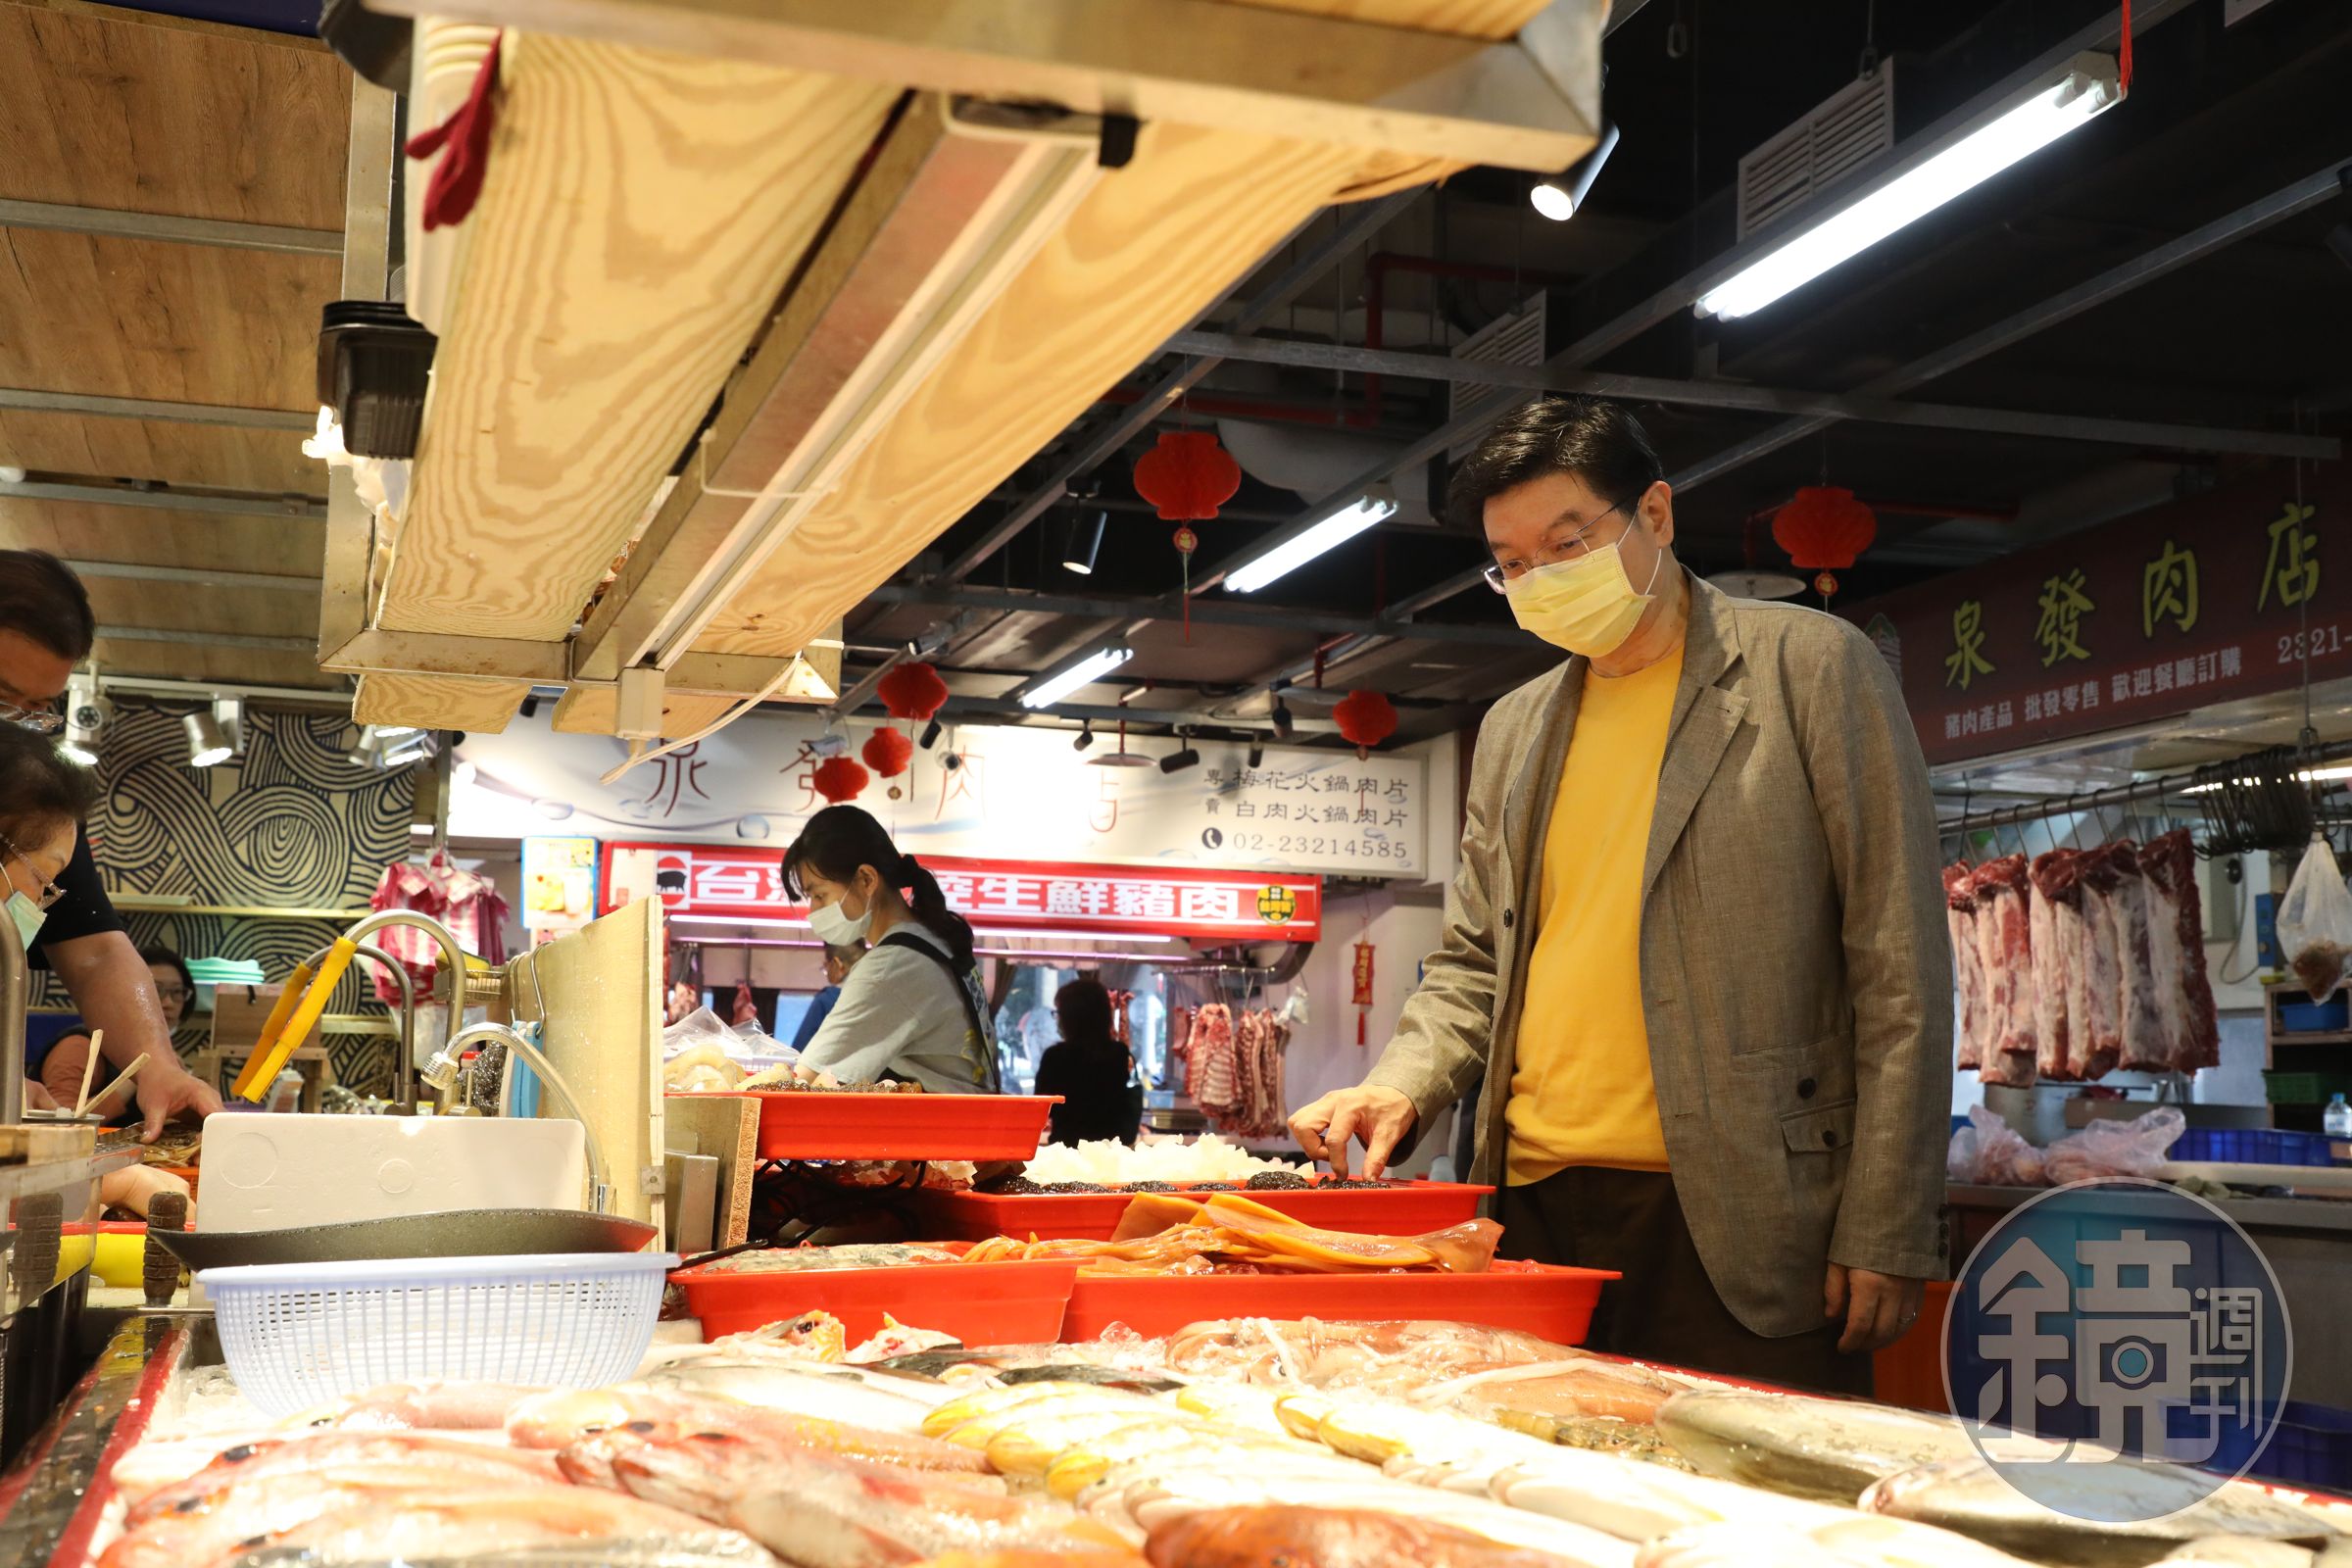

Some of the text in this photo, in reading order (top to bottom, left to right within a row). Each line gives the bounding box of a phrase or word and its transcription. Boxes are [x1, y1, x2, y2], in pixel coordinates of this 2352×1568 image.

[1945, 503, 2321, 690] 泉發肉店
[1944, 701, 2014, 740] 豬肉產品
[2025, 680, 2100, 722] 批發零售
[2112, 646, 2242, 704] 歡迎餐廳訂購
[1232, 768, 1409, 798] 梅花火鍋肉片
[1236, 800, 1409, 828] 白肉火鍋肉片
[1233, 832, 1407, 859] 02-23214585
